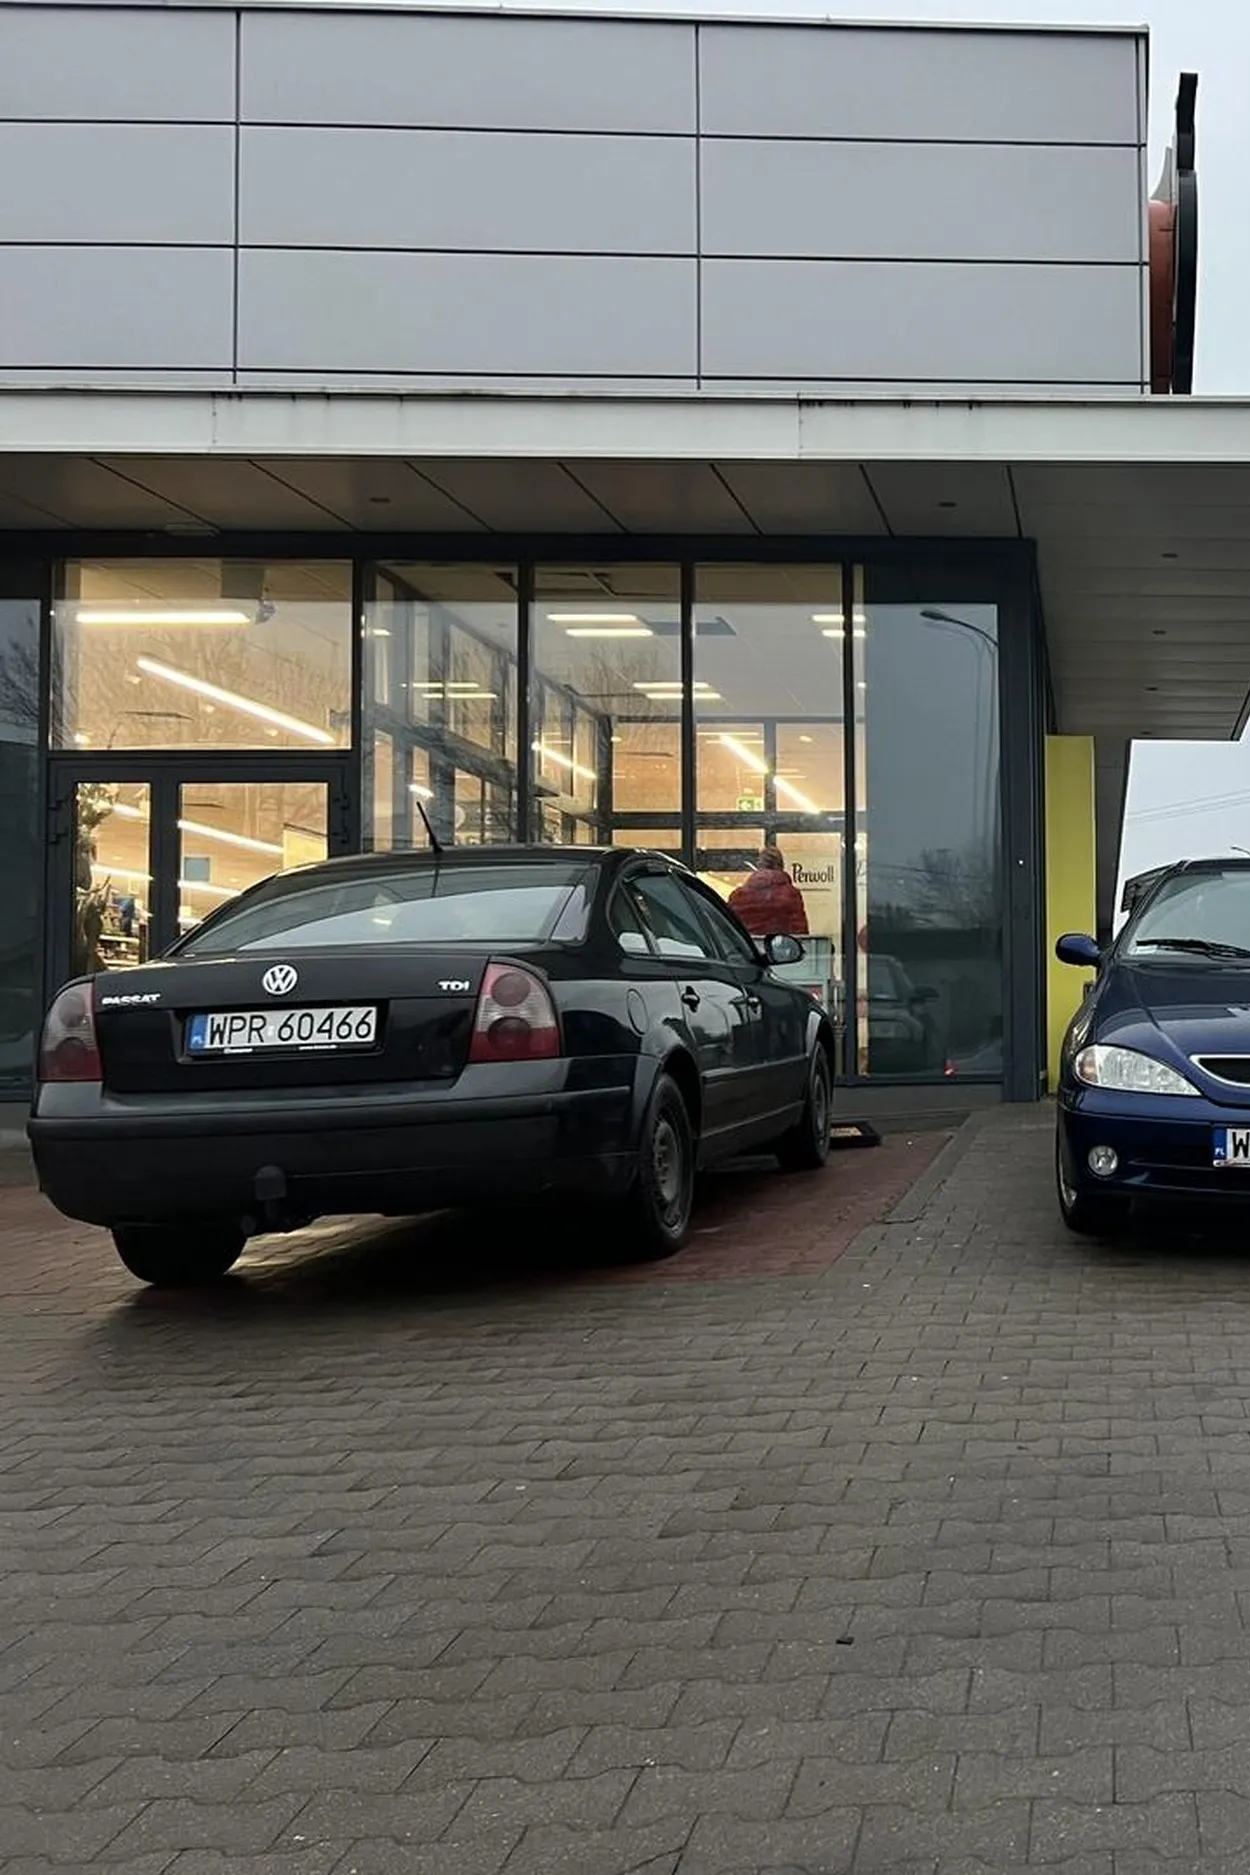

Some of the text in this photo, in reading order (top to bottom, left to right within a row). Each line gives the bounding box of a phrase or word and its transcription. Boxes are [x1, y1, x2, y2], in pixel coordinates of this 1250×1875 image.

[792, 863, 834, 883] Perwoll
[438, 980, 470, 991] TDI
[101, 993, 161, 1005] PASSAT
[209, 1010, 374, 1045] WPR 60466
